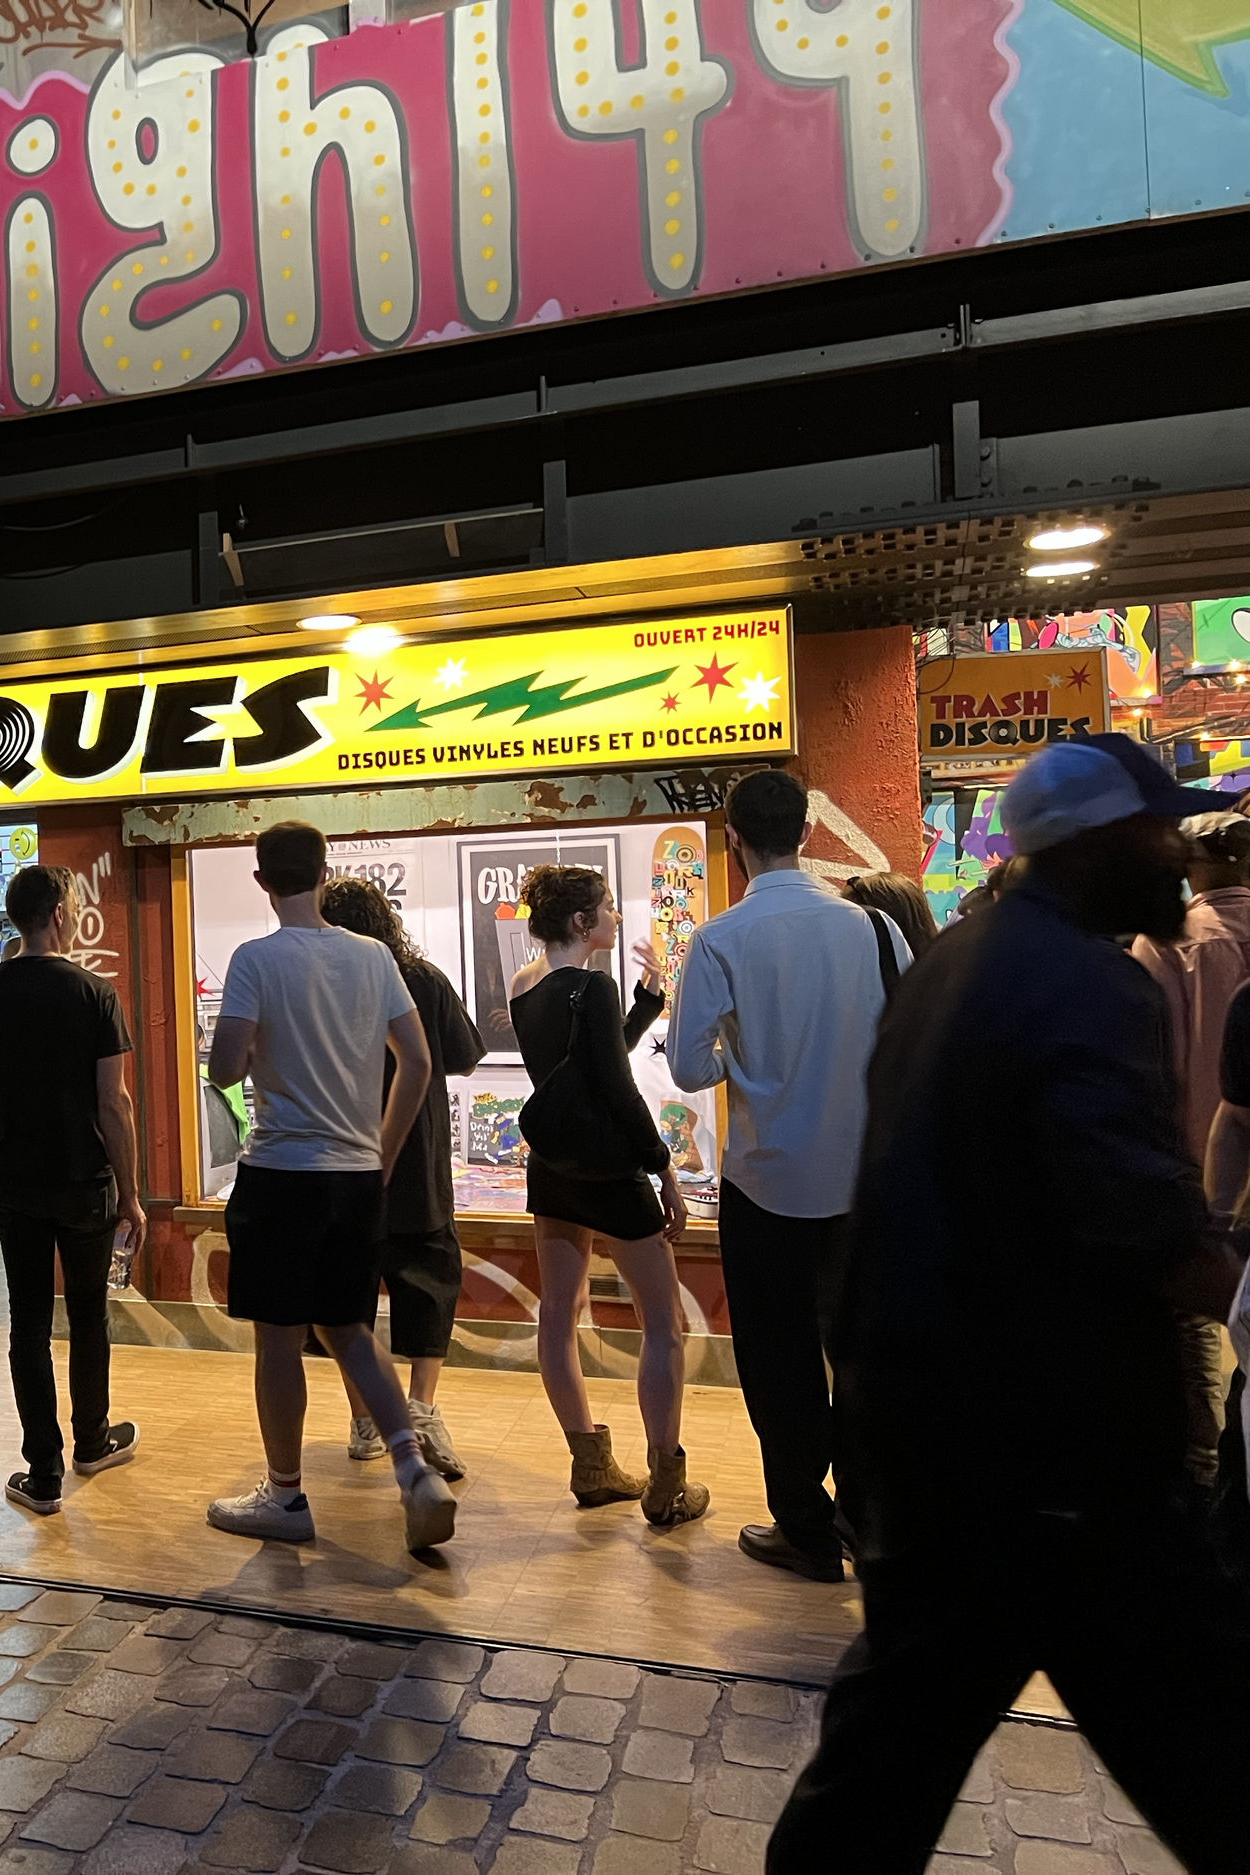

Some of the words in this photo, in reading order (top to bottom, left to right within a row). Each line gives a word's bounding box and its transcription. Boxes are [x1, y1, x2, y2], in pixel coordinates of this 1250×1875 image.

[634, 632, 707, 647] OUVERT
[713, 620, 780, 638] 24H/24
[930, 690, 1048, 720] TRASH
[338, 750, 426, 770] DISQUES
[433, 740, 525, 762] VINYLES
[533, 735, 600, 756] NEUFS
[609, 732, 634, 750] ET
[642, 722, 783, 748] D'OCCASION
[930, 717, 1090, 747] DISQUES
[348, 840, 391, 851] NEWS
